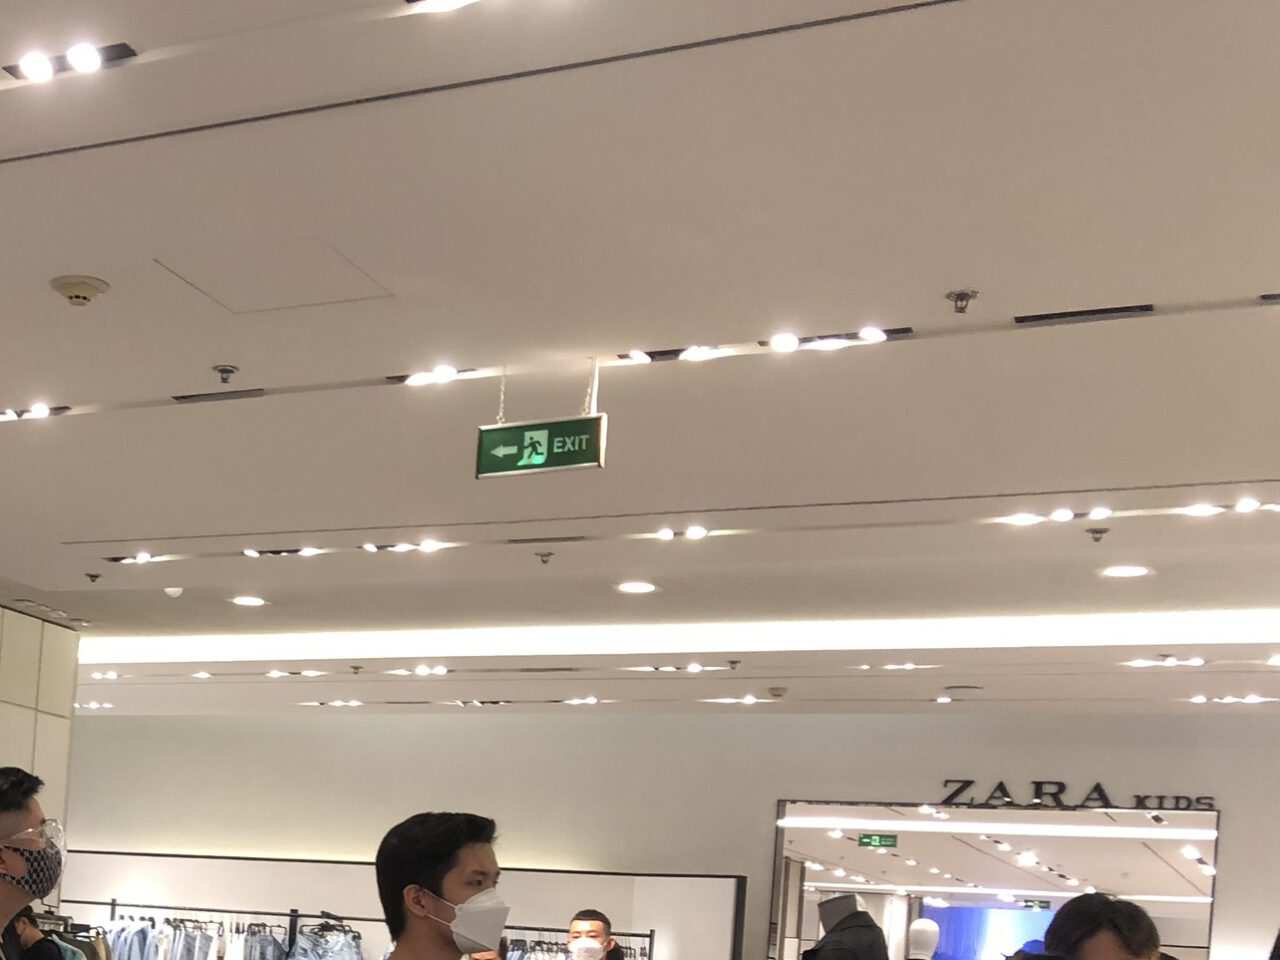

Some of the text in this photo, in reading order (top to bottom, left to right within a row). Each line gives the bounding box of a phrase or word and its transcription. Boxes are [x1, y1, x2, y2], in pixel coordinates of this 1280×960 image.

[553, 435, 589, 453] EXIT
[942, 778, 1215, 810] ZARA KIDS
